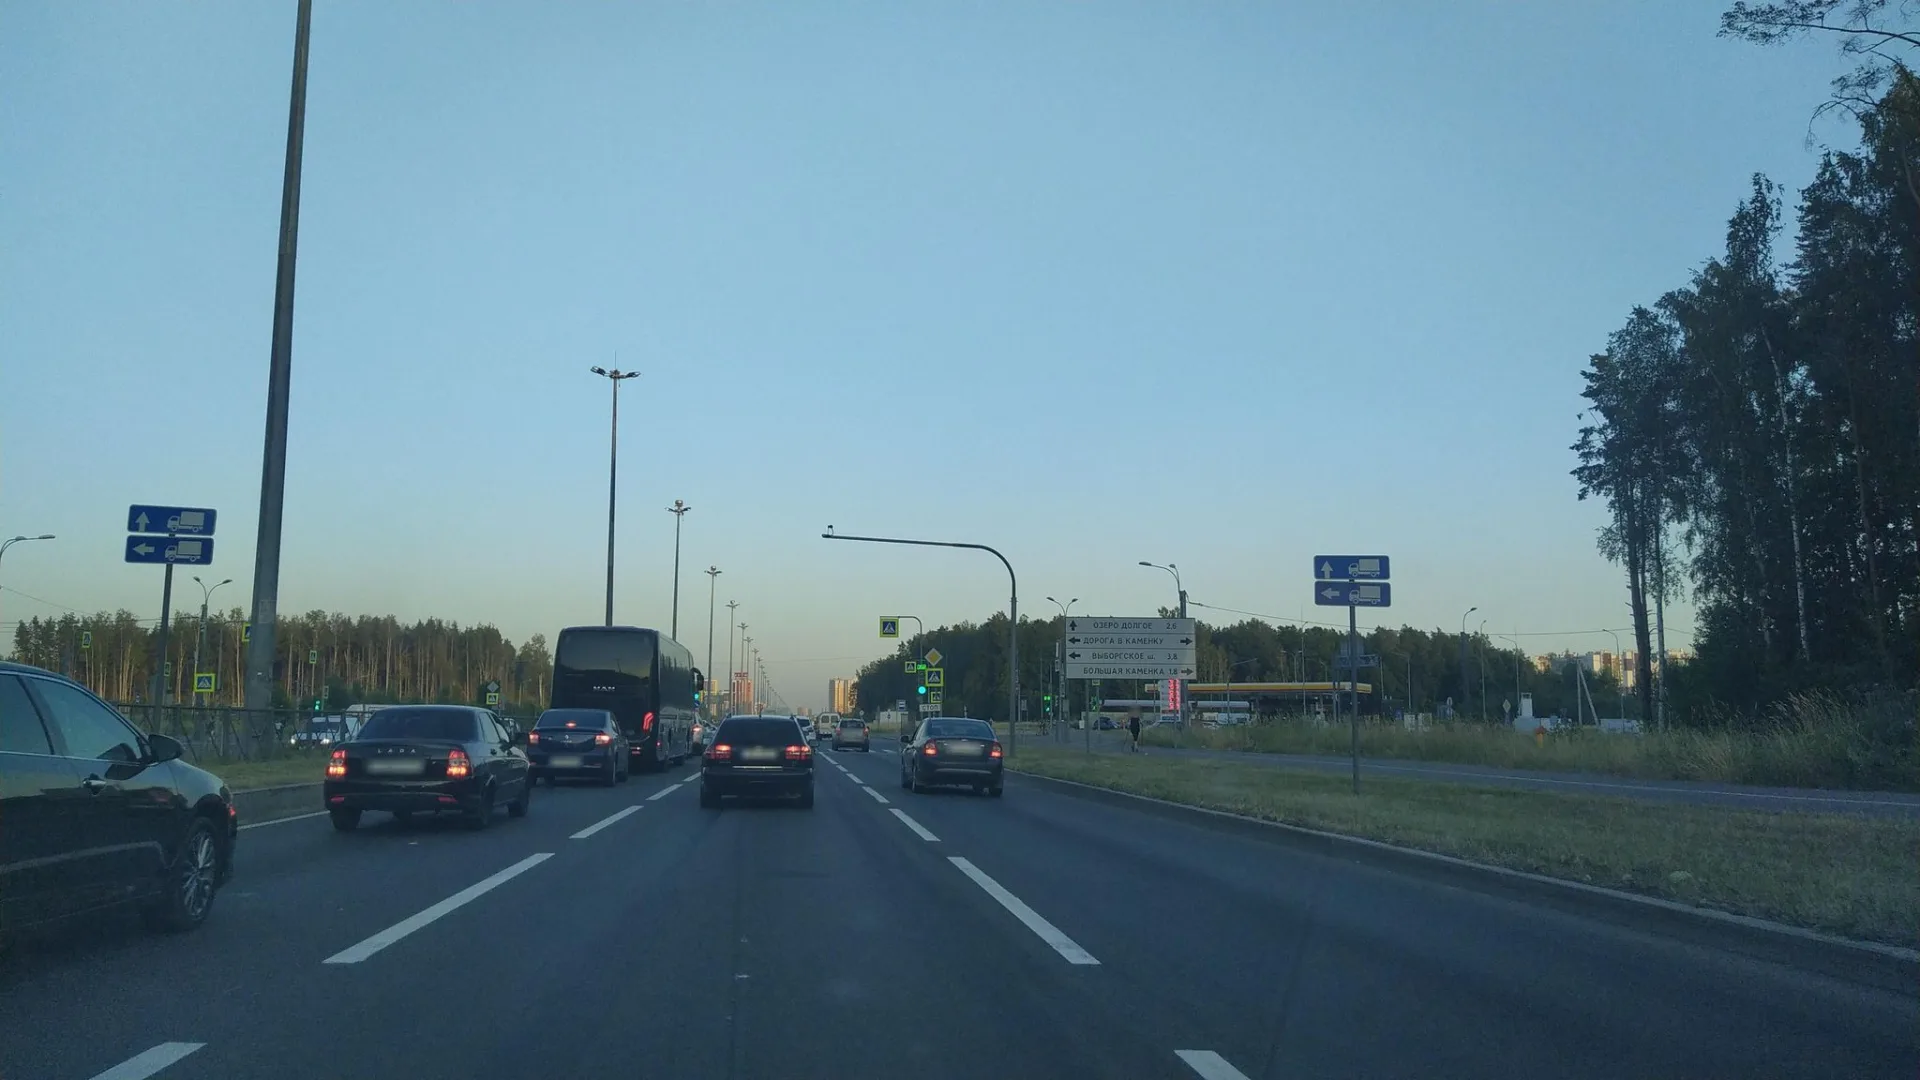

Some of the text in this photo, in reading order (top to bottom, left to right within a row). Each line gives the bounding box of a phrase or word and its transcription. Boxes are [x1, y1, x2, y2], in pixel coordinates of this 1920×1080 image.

[1093, 621, 1118, 629] ОЗЕРО
[1121, 622, 1152, 630] ДОЛГОЕ
[1083, 637, 1164, 645] ДОРОГА В КАМЕНКУ
[1092, 652, 1144, 660] ВЫБОРГСКОЕ
[1083, 667, 1123, 675] БОЛЬШАЯ
[1126, 667, 1164, 675] КАМЕНКА
